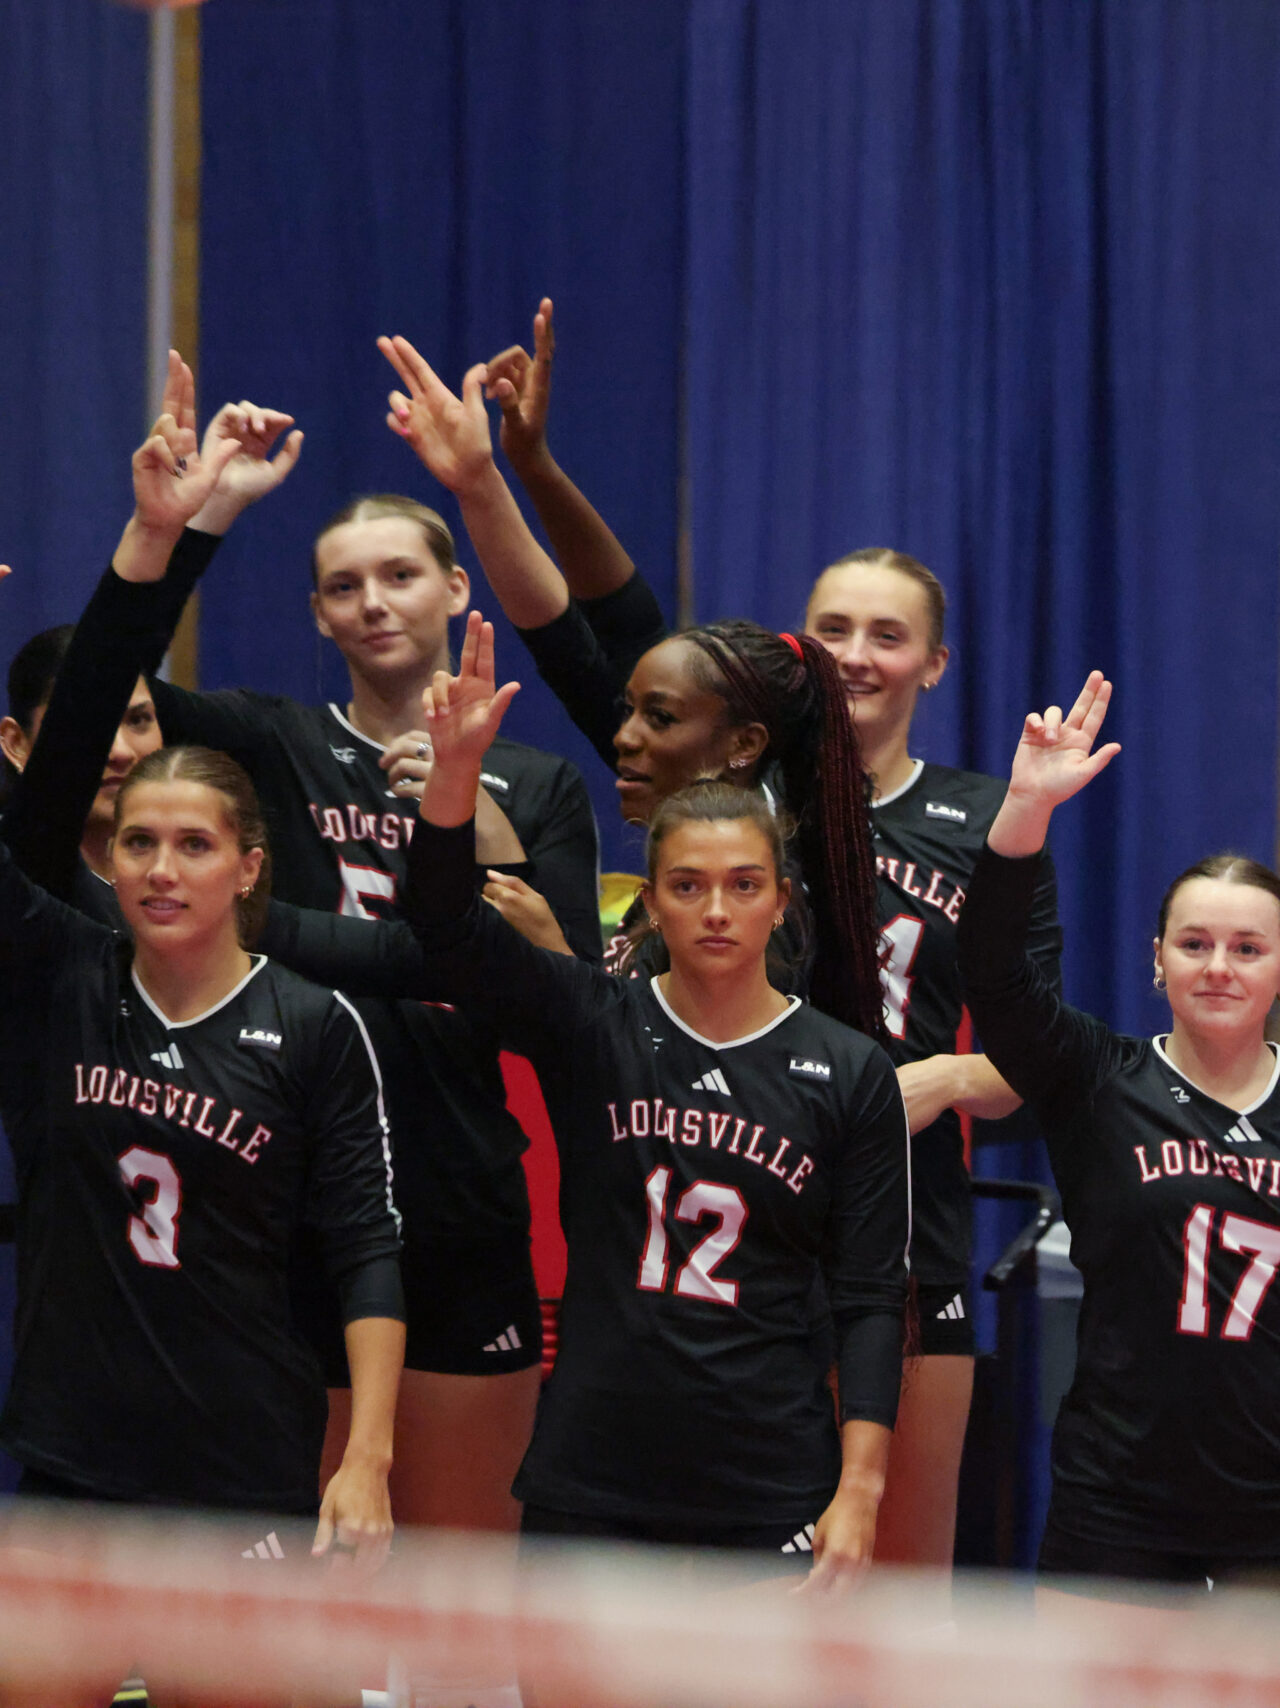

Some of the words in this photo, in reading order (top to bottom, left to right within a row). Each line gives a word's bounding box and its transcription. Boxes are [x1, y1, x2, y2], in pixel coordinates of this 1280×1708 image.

[308, 802, 417, 849] LOUISV
[238, 1028, 282, 1045] L&N
[789, 1058, 831, 1076] L&N
[74, 1063, 273, 1166] LOUISVILLE
[607, 1098, 815, 1195] LOUISVILLE
[116, 1144, 184, 1271] 3
[635, 1163, 750, 1308] 12
